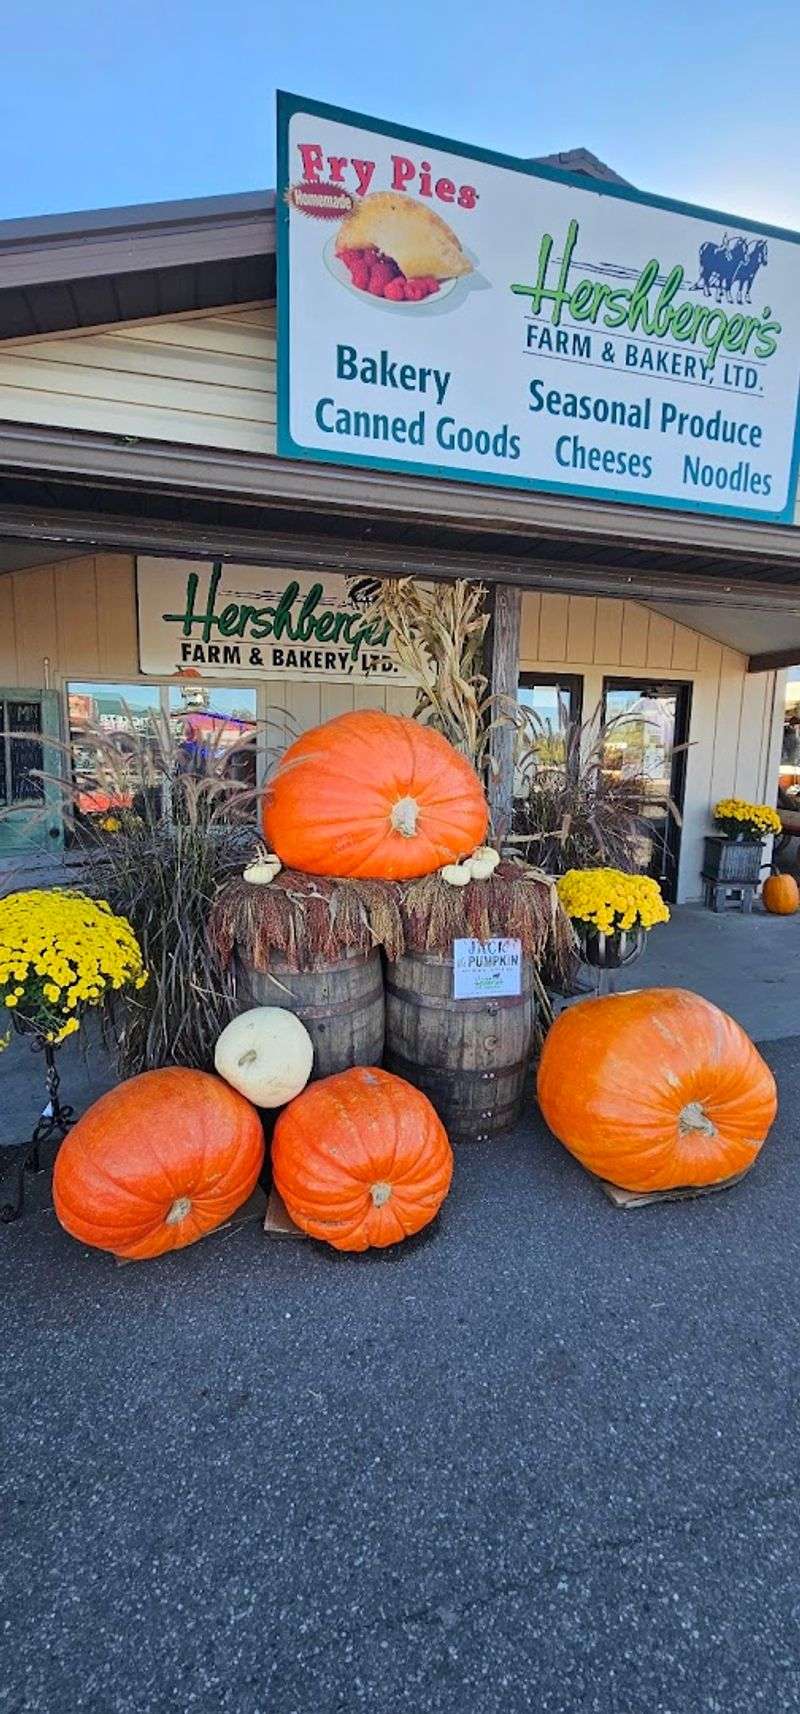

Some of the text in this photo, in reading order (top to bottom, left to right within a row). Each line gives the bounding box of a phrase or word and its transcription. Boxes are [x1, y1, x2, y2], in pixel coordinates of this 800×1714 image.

[295, 188, 352, 210] Homemade
[298, 144, 479, 209] Fry Pies
[510, 219, 781, 358] Hershberger's
[336, 344, 451, 405] Bakery
[526, 325, 764, 391] FARM & BAKERY, LTD.
[315, 397, 521, 460] Canned Goods
[529, 379, 762, 448] Seasonal Produce
[555, 434, 773, 496] Cheeses Noodles
[181, 642, 399, 674] FARM & BAKERY, LTD.
[468, 955, 519, 968] PUMPKIN
